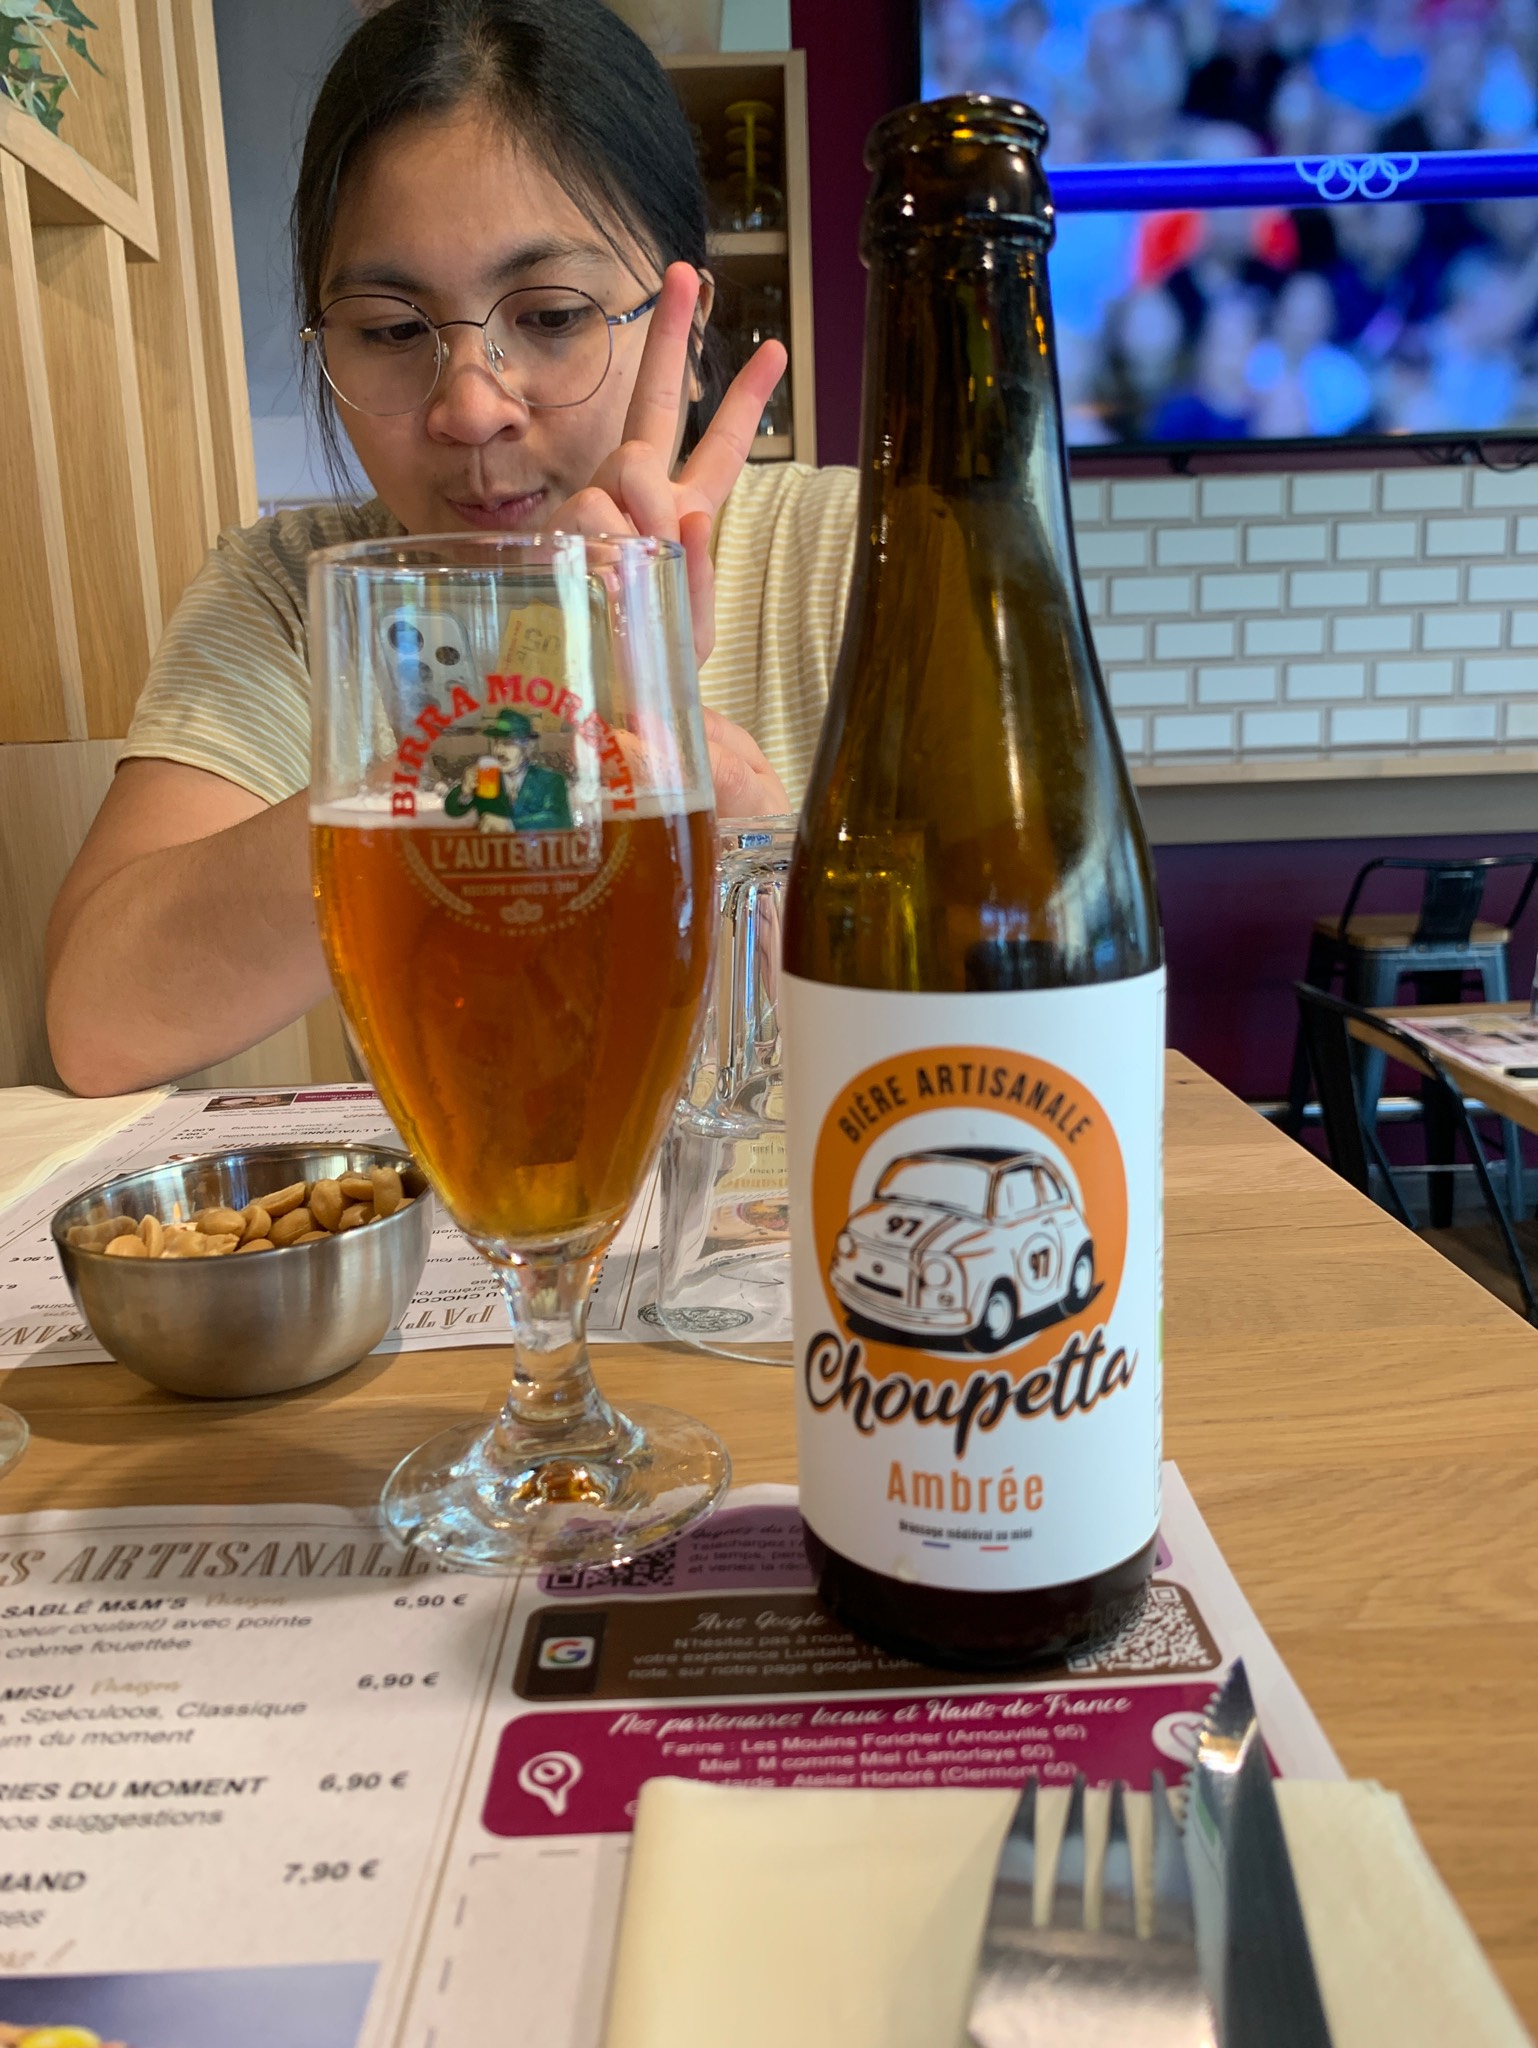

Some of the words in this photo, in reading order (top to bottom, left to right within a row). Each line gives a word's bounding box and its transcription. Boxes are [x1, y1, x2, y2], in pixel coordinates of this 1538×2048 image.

[391, 685, 481, 817] BIRRA
[486, 674, 636, 812] MORETTI
[838, 1075, 908, 1144] BIÈRE
[916, 1063, 1093, 1145] ARTISANALE
[886, 1214, 922, 1237] 97
[30, 1302, 76, 1312] pointe
[805, 1329, 1138, 1458] Choupetta
[886, 1461, 1044, 1514] Ambrée
[1011, 1527, 1032, 1539] miel
[1, 1599, 93, 1620] SABLÉ
[98, 1596, 188, 1614] M&M'S
[394, 1595, 445, 1609] 6,90
[453, 1594, 468, 1606] €
[172, 1617, 232, 1632] avec
[236, 1613, 313, 1631] pointe
[691, 1610, 747, 1632] Avis
[755, 1609, 827, 1631] Google
[5, 1642, 84, 1660] crème
[90, 1637, 192, 1654] fouettée
[673, 1636, 754, 1650] N'hésitez
[758, 1634, 790, 1647] pas
[811, 1632, 854, 1644] nous
[633, 1652, 678, 1665] votre
[683, 1647, 779, 1664] expérience
[678, 1665, 706, 1678] sur
[711, 1663, 757, 1677] notre
[762, 1661, 807, 1677] page
[812, 1659, 873, 1674] google
[357, 1673, 415, 1691] 6,90
[422, 1671, 439, 1688] €
[176, 1701, 308, 1722] Classique
[609, 1712, 657, 1737] Nos
[655, 1712, 804, 1741] partenaires
[811, 1706, 888, 1728] locaux
[893, 1700, 919, 1722] et
[39, 1729, 75, 1748] du
[81, 1727, 195, 1747] moment
[661, 1740, 725, 1758] Farine
[741, 1738, 777, 1754] Les
[781, 1735, 857, 1752] Moulins
[862, 1730, 942, 1748] Foricher
[699, 1757, 741, 1775] Miel
[757, 1755, 777, 1772] M
[781, 1754, 855, 1772] comme
[859, 1750, 900, 1768] Miel
[905, 1746, 1016, 1767] (Lamorlaye
[1020, 1743, 1054, 1762] 60)
[68, 1780, 117, 1801] DU
[123, 1776, 269, 1799] MOMENT
[318, 1772, 382, 1794] 6,90
[390, 1769, 409, 1791] €
[791, 1771, 855, 1788] Atelier
[861, 1766, 935, 1787] Honoré
[47, 1808, 224, 1835] suggestions
[283, 1859, 350, 1887] 7,90
[359, 1858, 381, 1881] €
